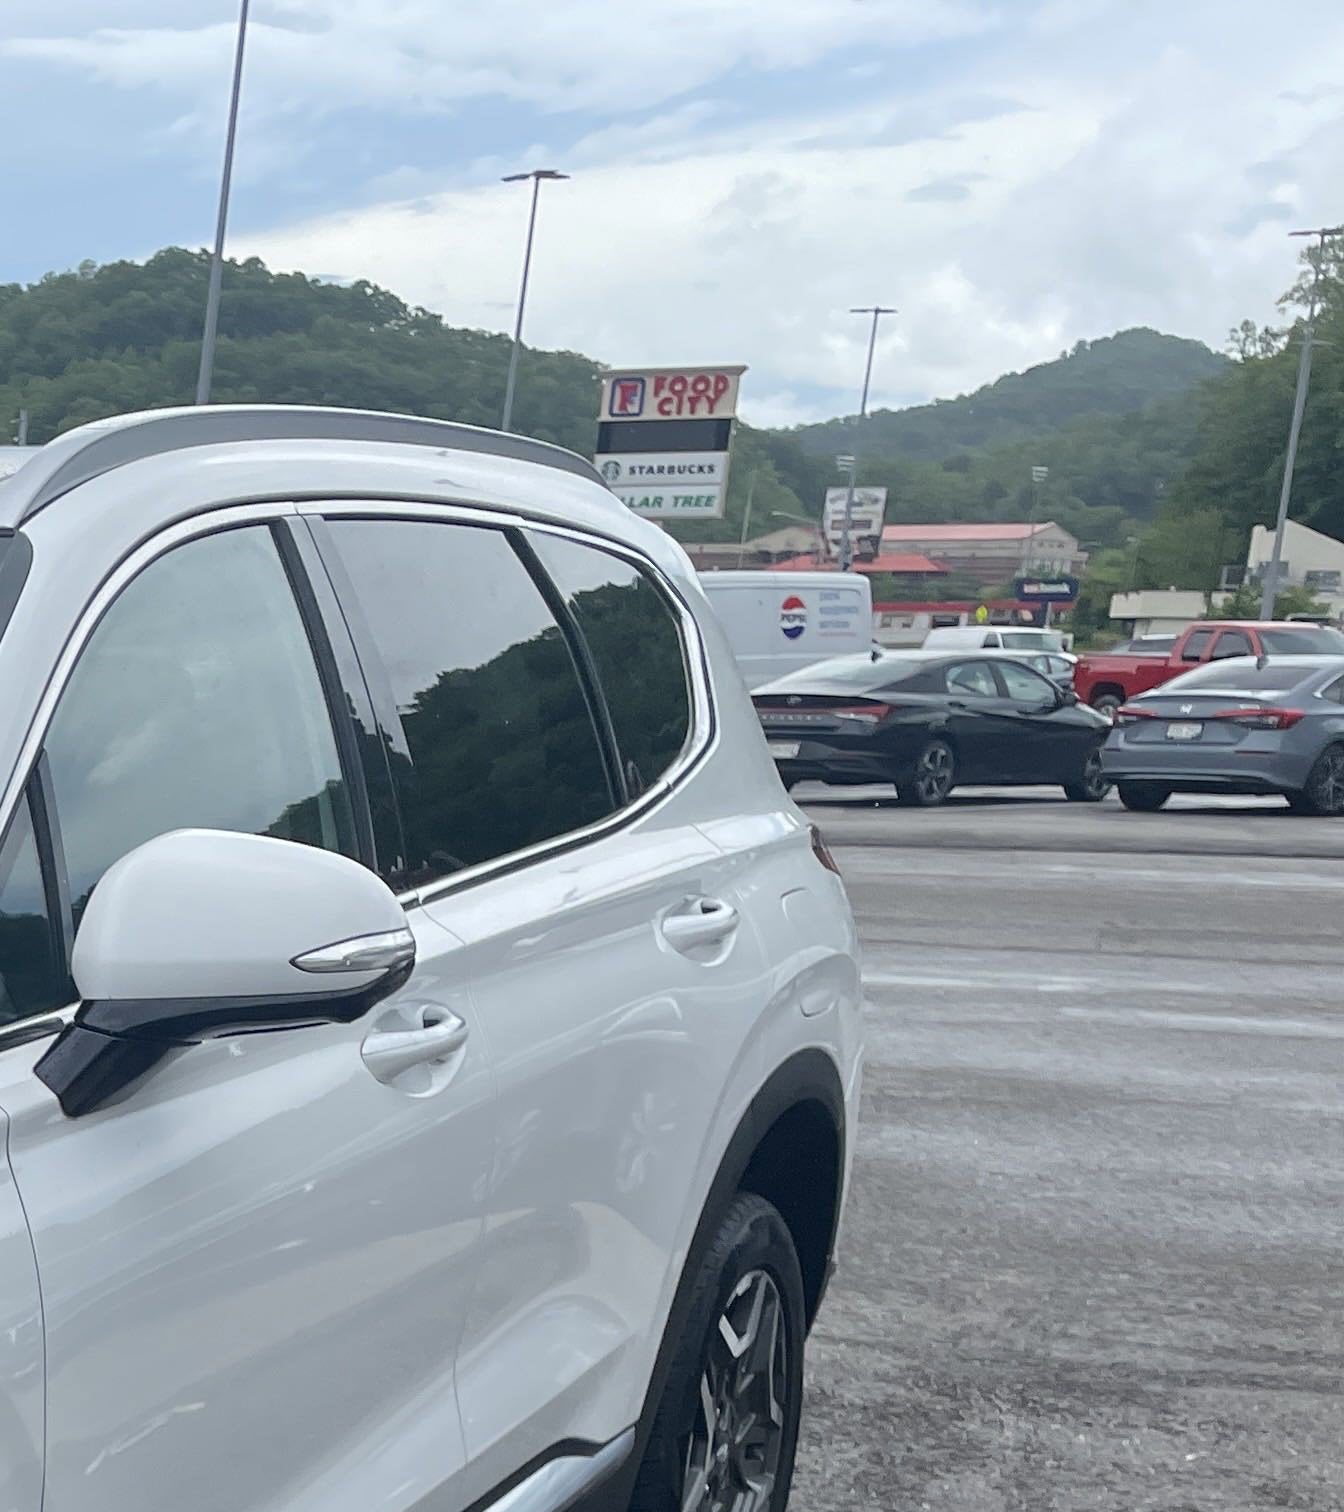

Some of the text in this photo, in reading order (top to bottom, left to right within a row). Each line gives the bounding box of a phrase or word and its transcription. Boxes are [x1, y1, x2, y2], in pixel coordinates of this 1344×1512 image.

[653, 374, 729, 398] FOOD
[657, 395, 716, 416] CITY
[628, 464, 715, 476] STARBUCKS
[672, 495, 716, 508] TREE
